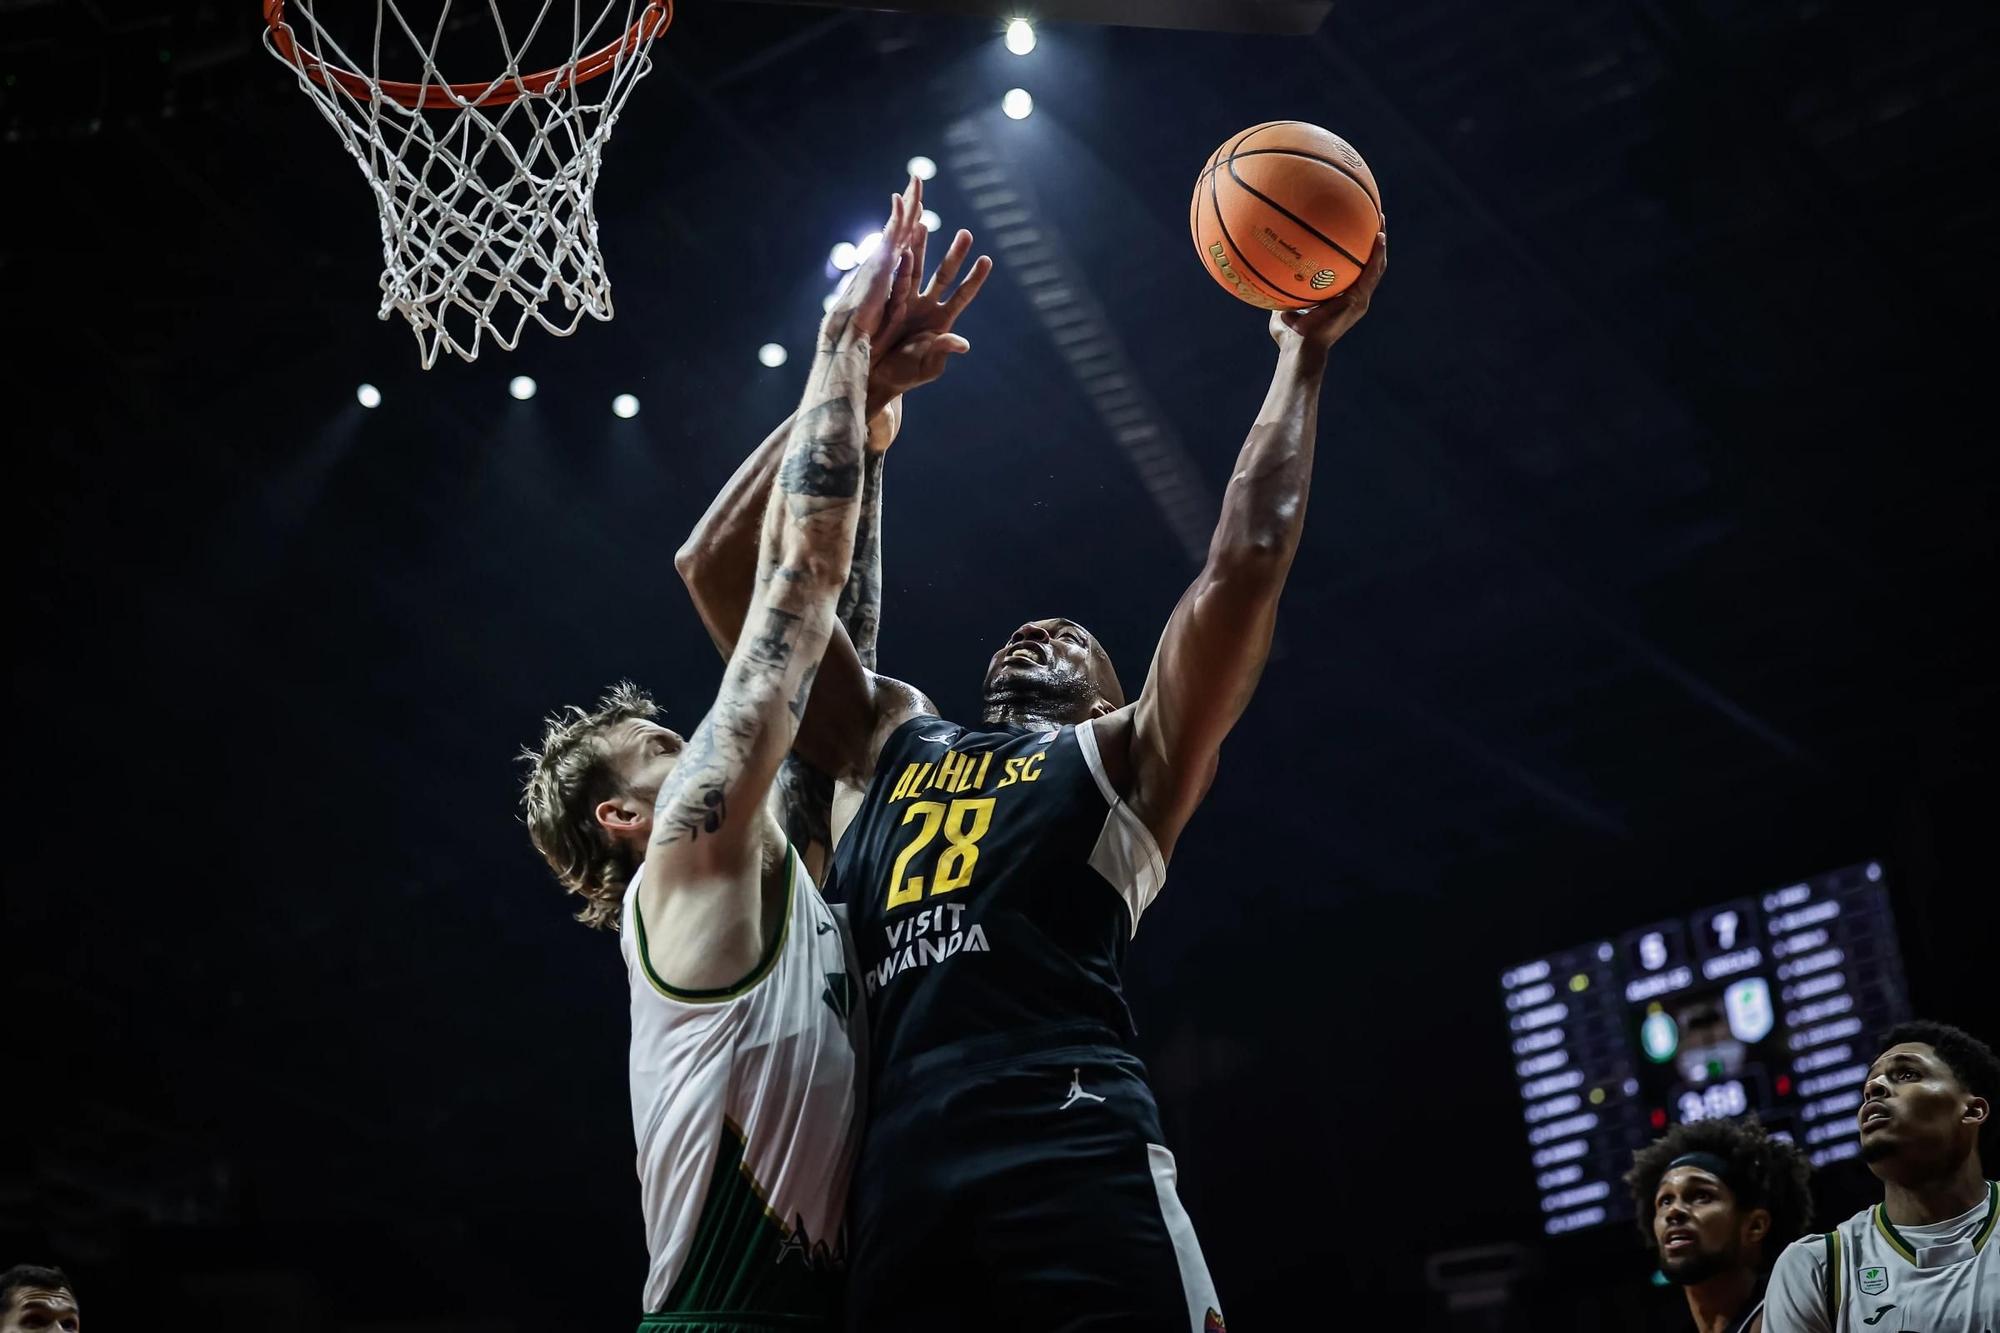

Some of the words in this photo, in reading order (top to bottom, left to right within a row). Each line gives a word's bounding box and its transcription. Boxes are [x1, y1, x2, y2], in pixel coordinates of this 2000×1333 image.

[997, 751, 1046, 789] SC
[886, 797, 997, 911] 28
[885, 903, 966, 949] VISIT
[865, 924, 991, 998] RWANDA
